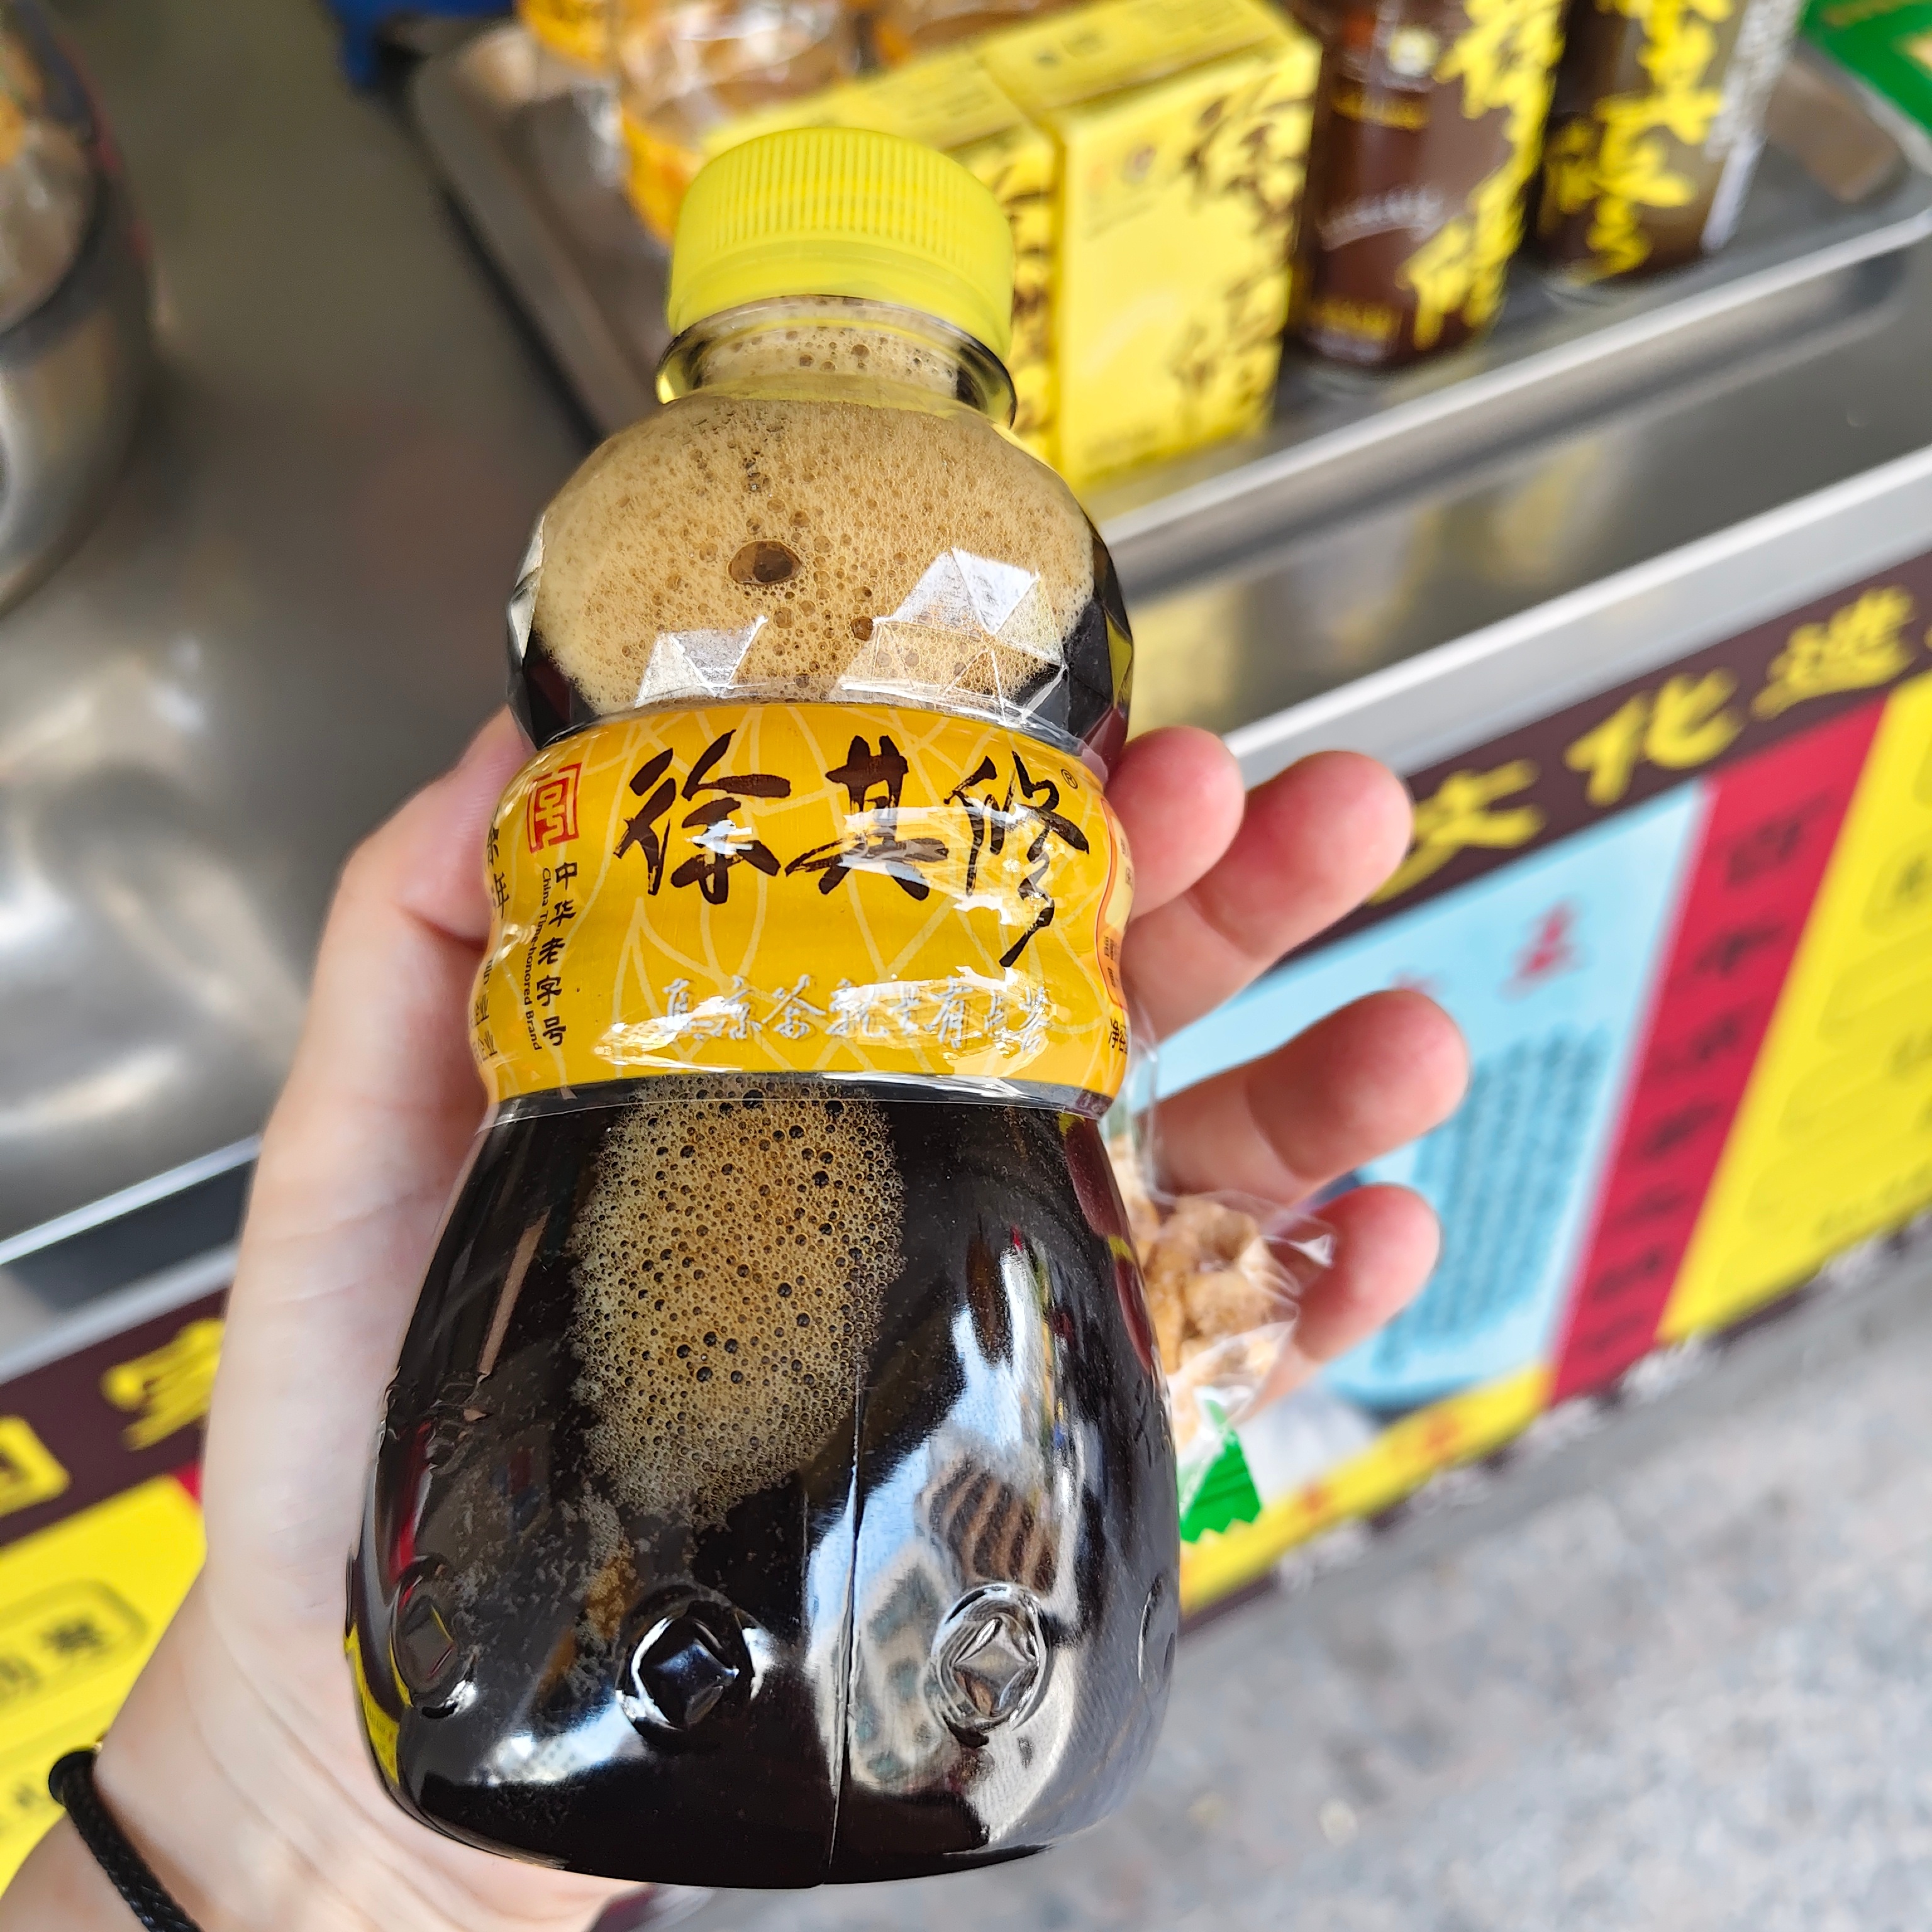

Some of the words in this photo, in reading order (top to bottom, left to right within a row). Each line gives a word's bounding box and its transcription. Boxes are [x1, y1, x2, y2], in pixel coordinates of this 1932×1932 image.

[541, 867, 552, 908] China
[613, 728, 1091, 969] 徐其修
[524, 909, 549, 1006] Time-honored
[535, 861, 578, 1046] 中华老字号
[525, 1009, 543, 1052] Brand
